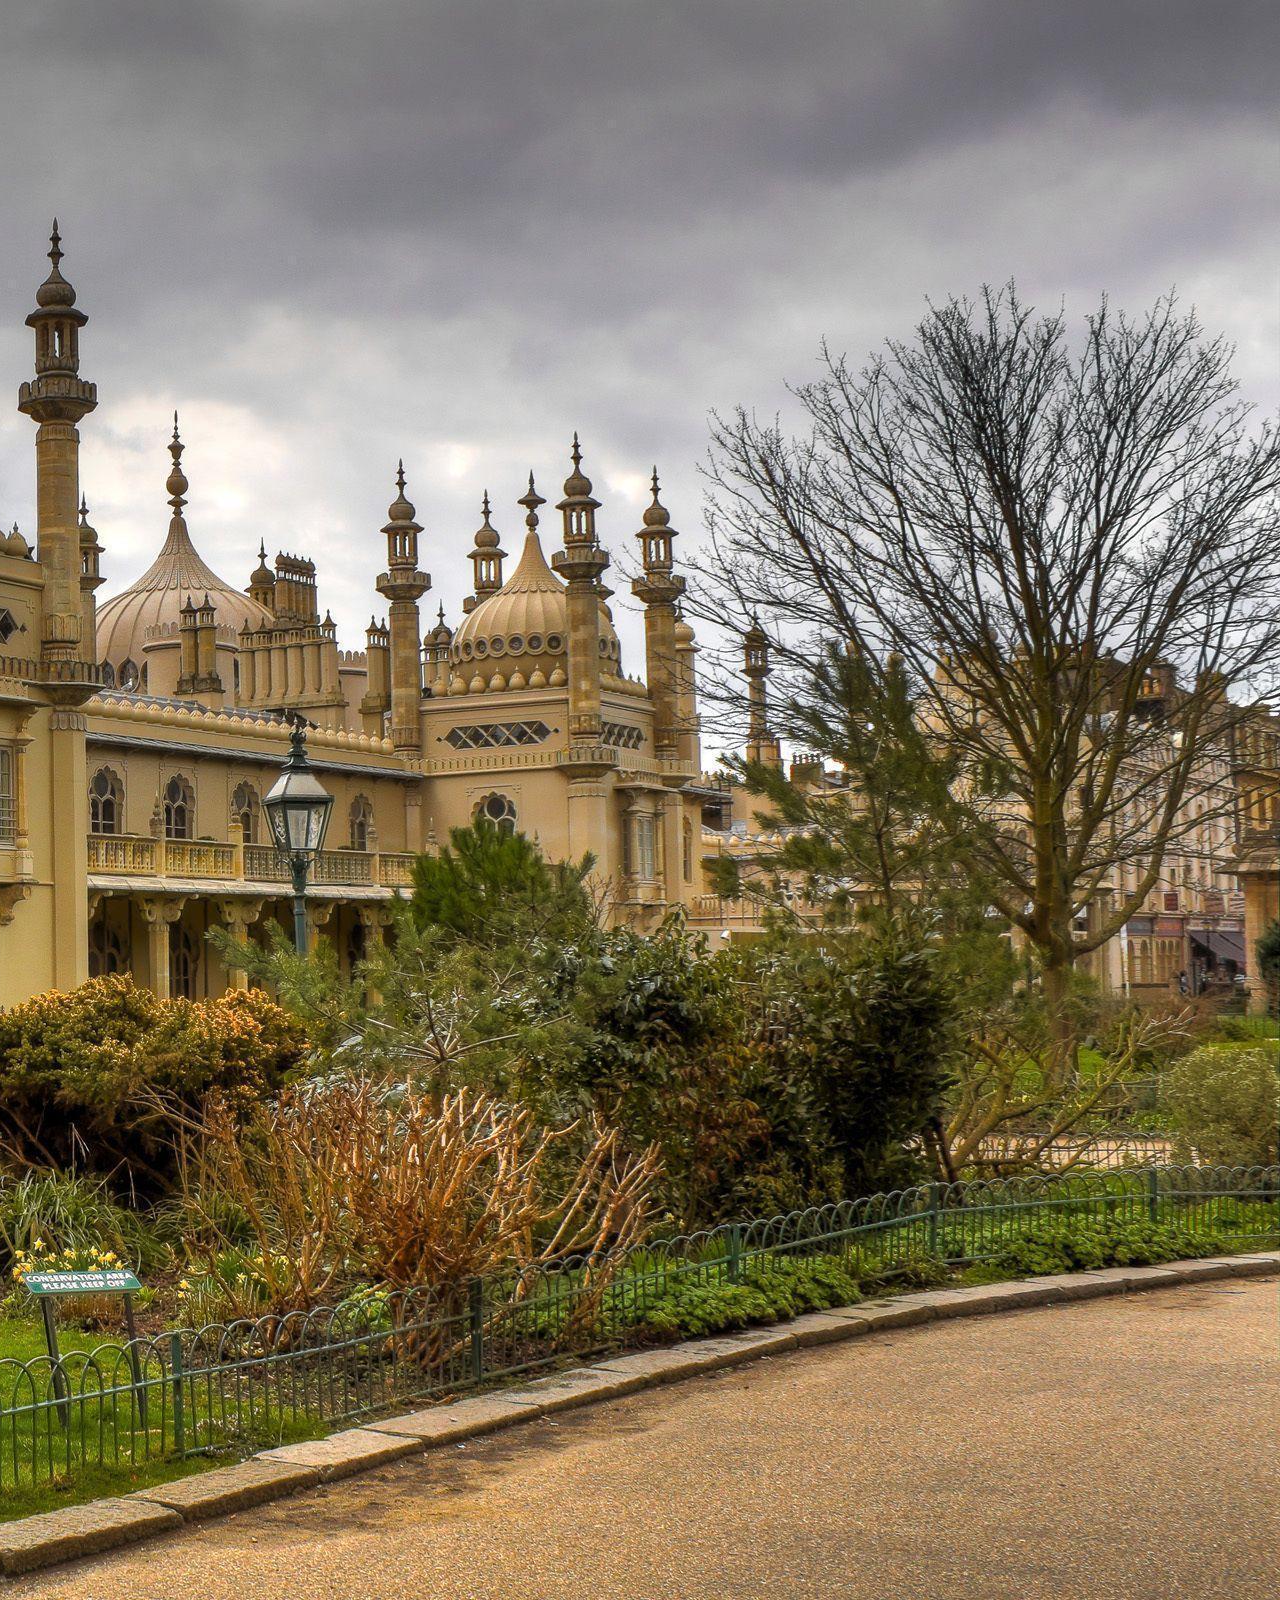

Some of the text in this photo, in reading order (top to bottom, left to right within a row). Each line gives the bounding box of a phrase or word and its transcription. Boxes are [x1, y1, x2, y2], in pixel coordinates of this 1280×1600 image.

[26, 1271, 133, 1283] CONSERVATION AREA
[41, 1280, 126, 1290] PLEASE KEEP OFF
